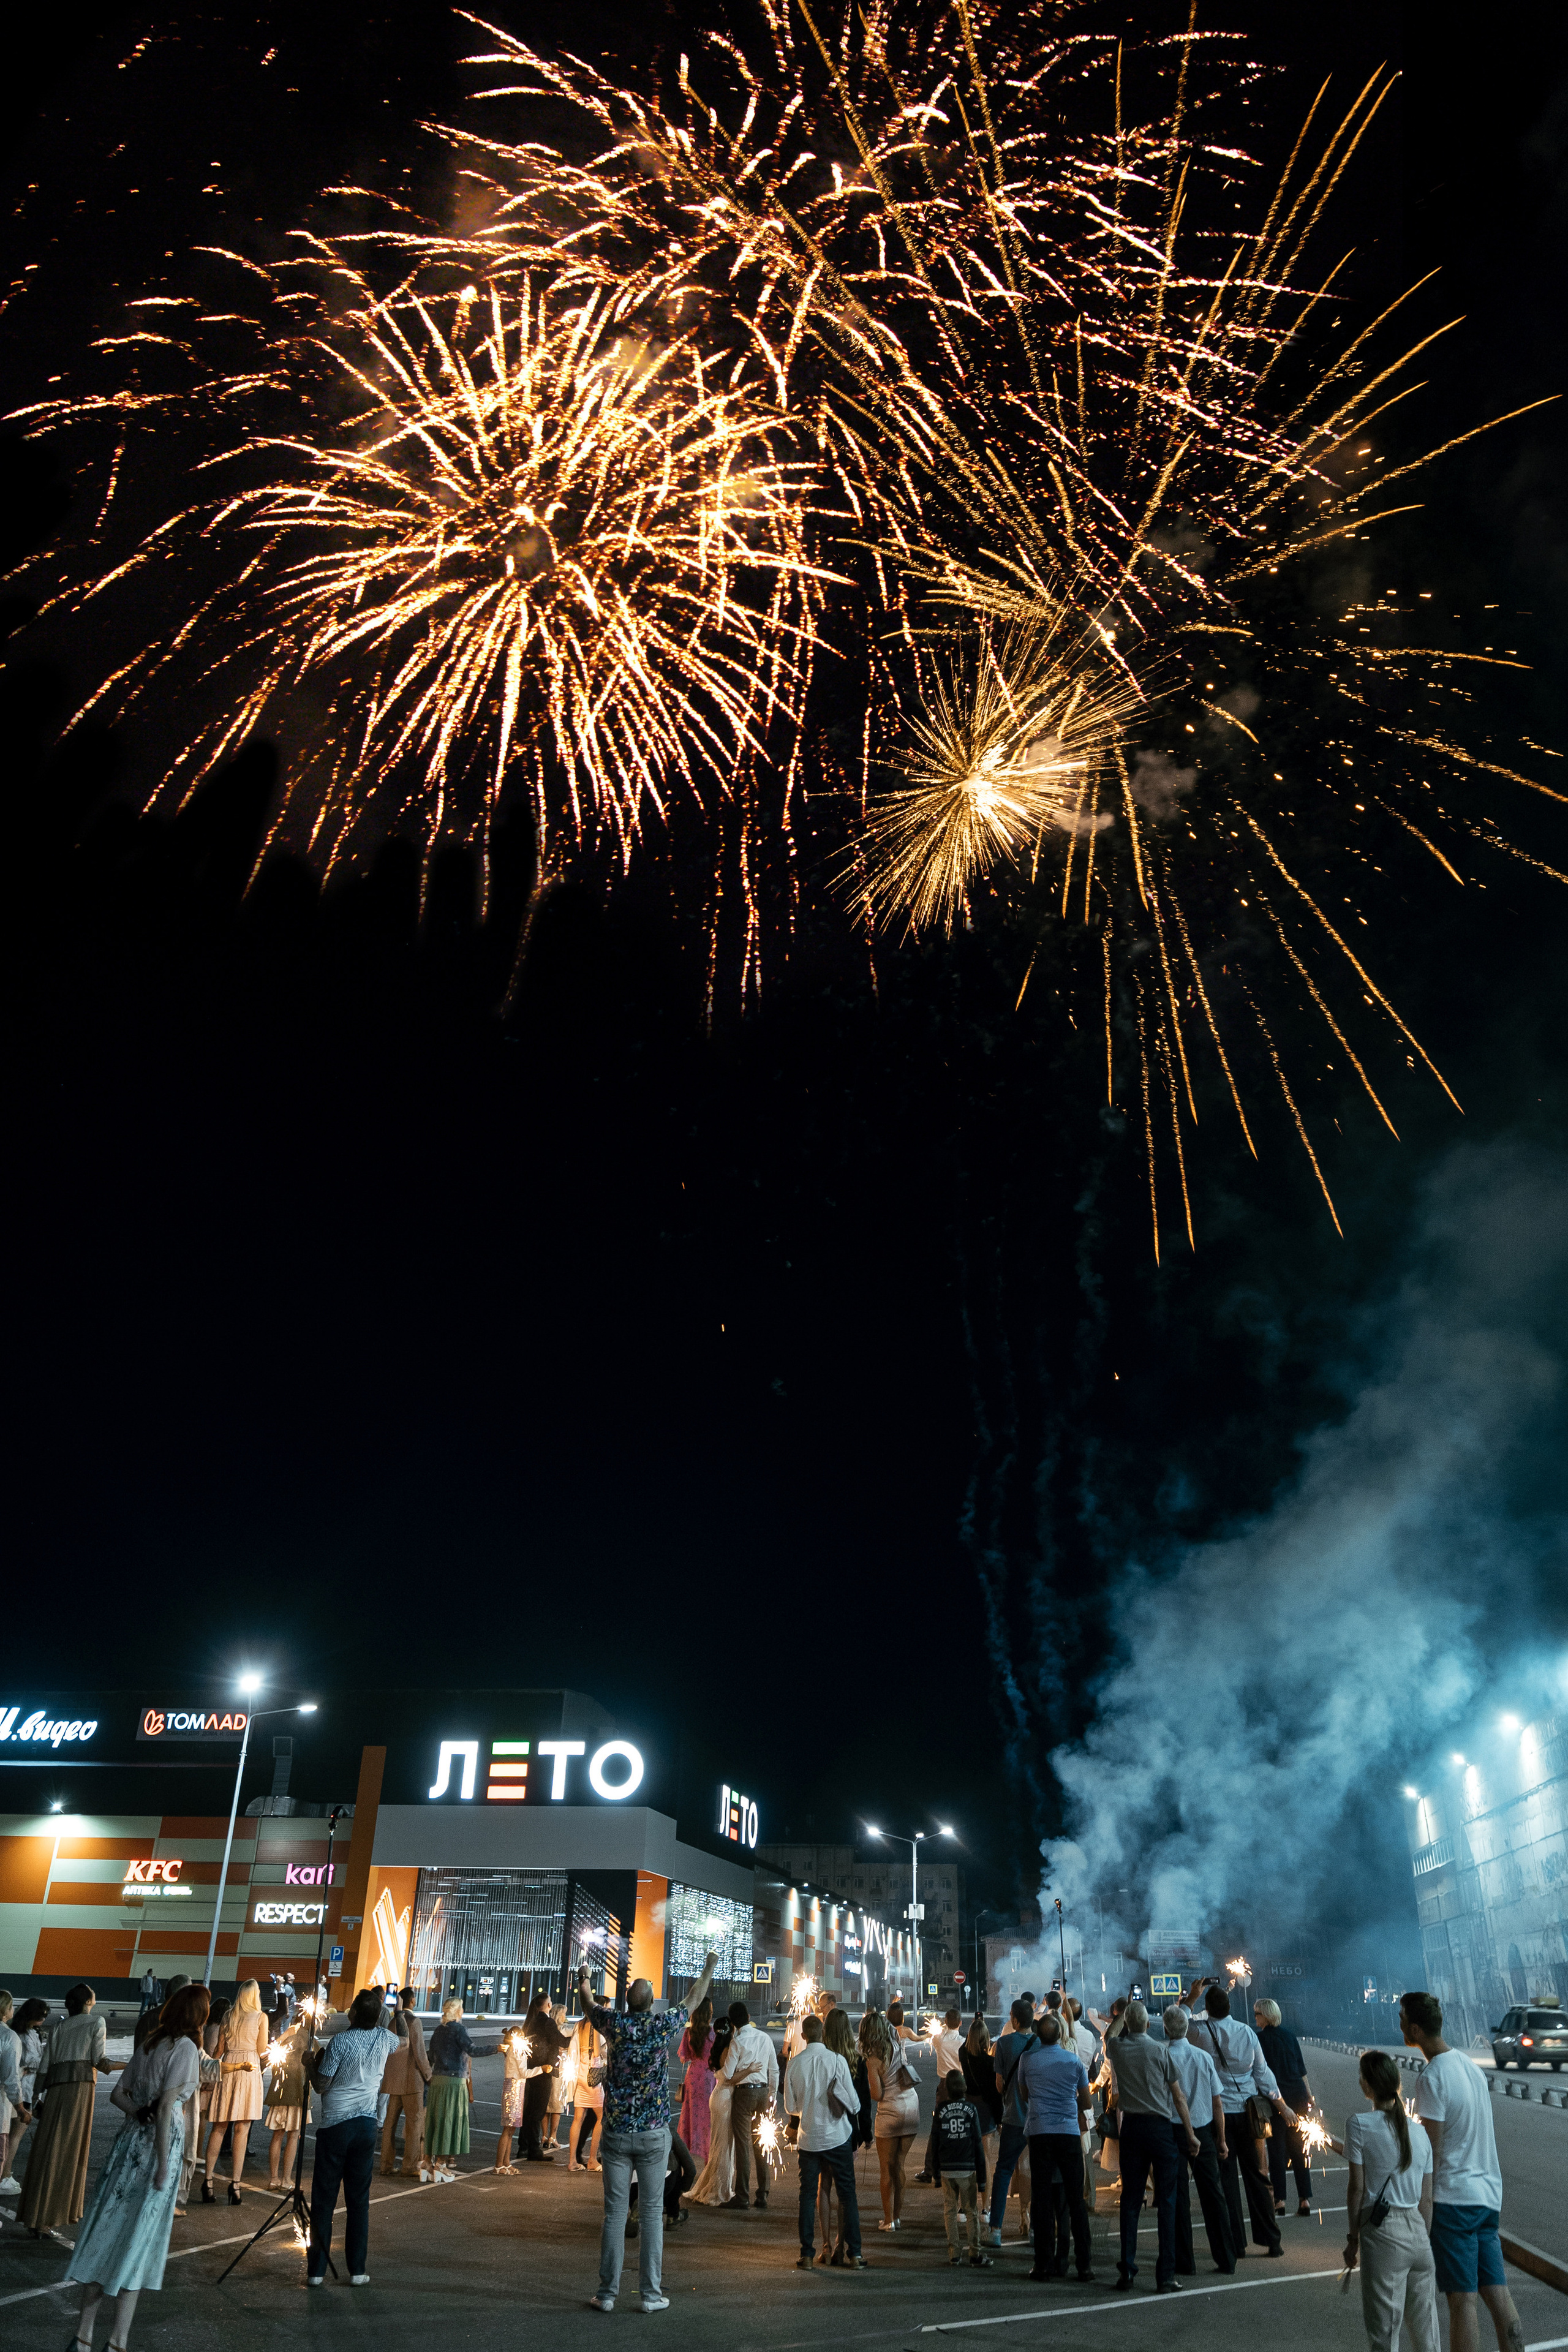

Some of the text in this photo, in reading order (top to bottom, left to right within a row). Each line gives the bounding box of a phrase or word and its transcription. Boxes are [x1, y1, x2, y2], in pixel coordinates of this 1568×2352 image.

[429, 1740, 644, 1800] ЛЕТО
[719, 1784, 759, 1849] ЛЕТО
[123, 1860, 183, 1882] KFC
[285, 1863, 334, 1885] kari
[254, 1903, 329, 1924] RESPECT
[333, 1948, 341, 1959] P
[1271, 1966, 1302, 1975] НЕБО
[938, 2107, 948, 2119] SAN
[950, 2119, 965, 2133] 85
